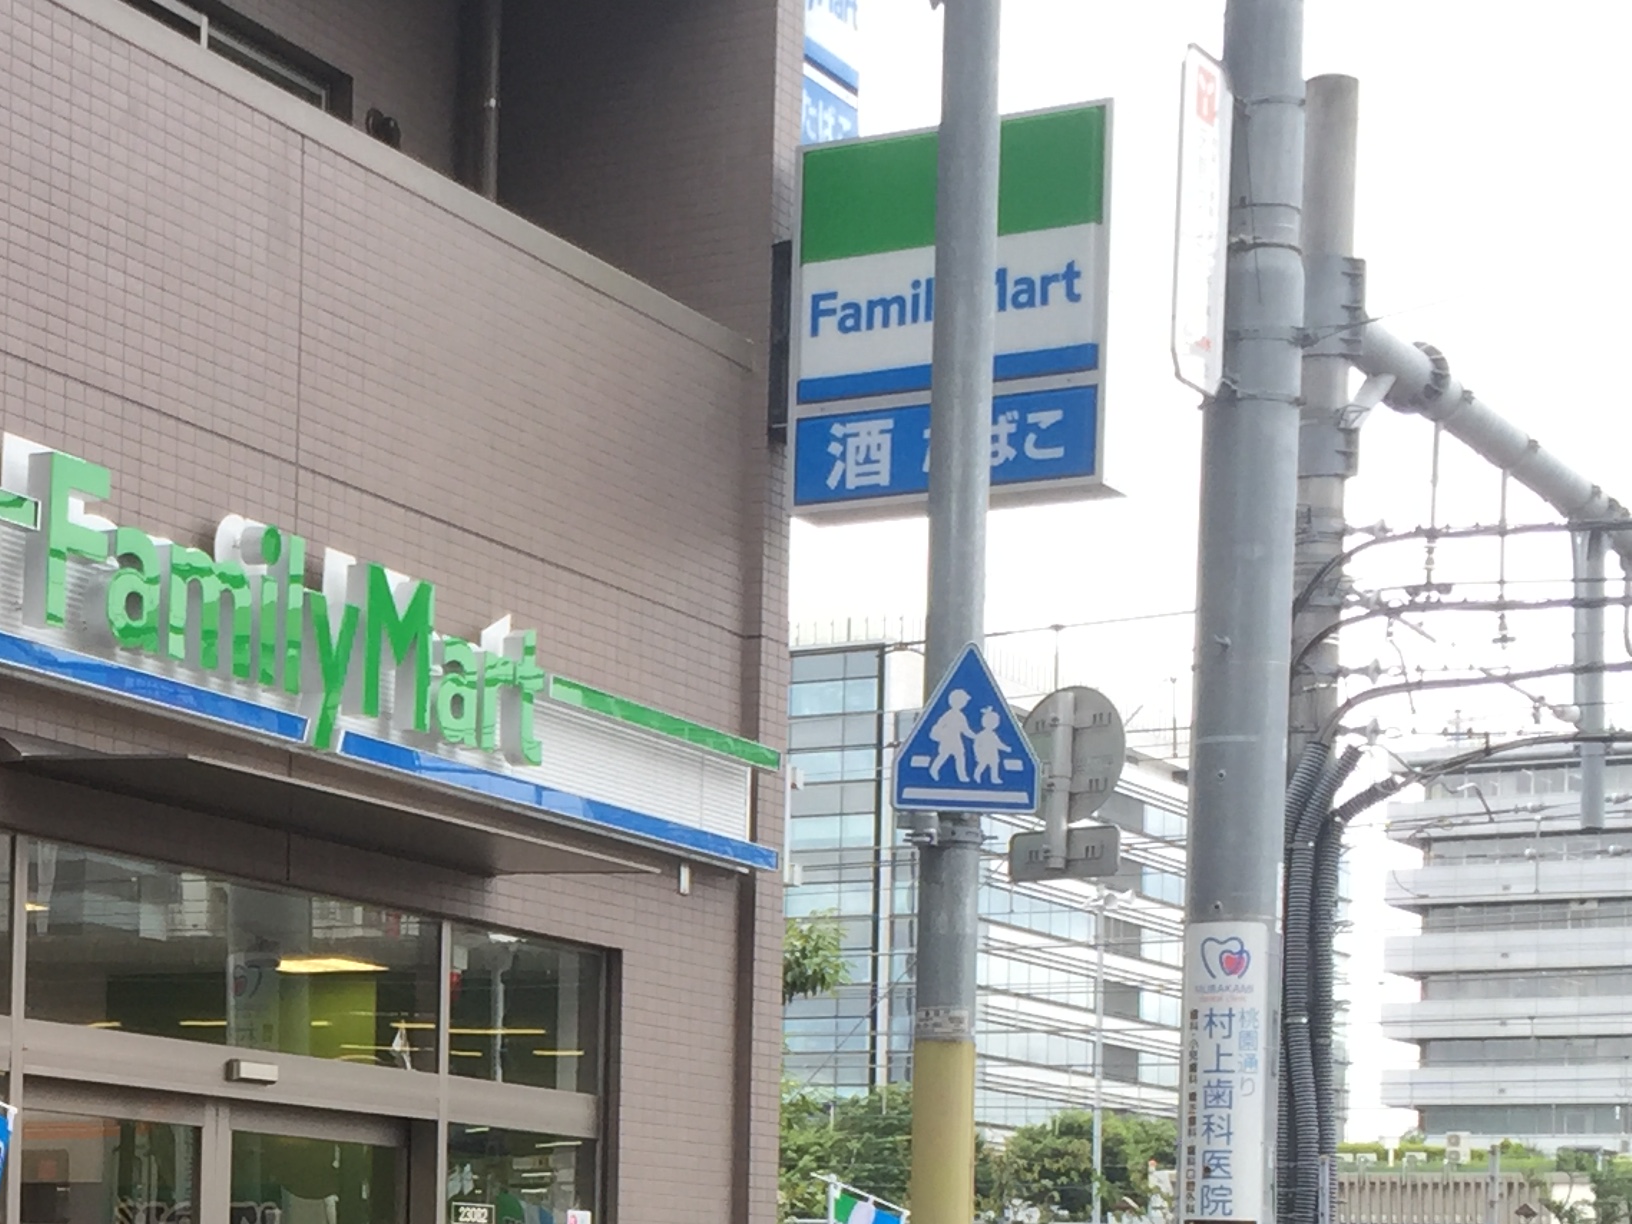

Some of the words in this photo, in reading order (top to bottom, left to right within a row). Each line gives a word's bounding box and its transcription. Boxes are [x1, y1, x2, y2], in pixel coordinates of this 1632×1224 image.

[810, 259, 1081, 338] Familart
[826, 418, 894, 490] 酒
[922, 409, 1065, 473] ばこ
[32, 451, 544, 766] FamilyMart
[1201, 1007, 1236, 1217] 村上歯科医院
